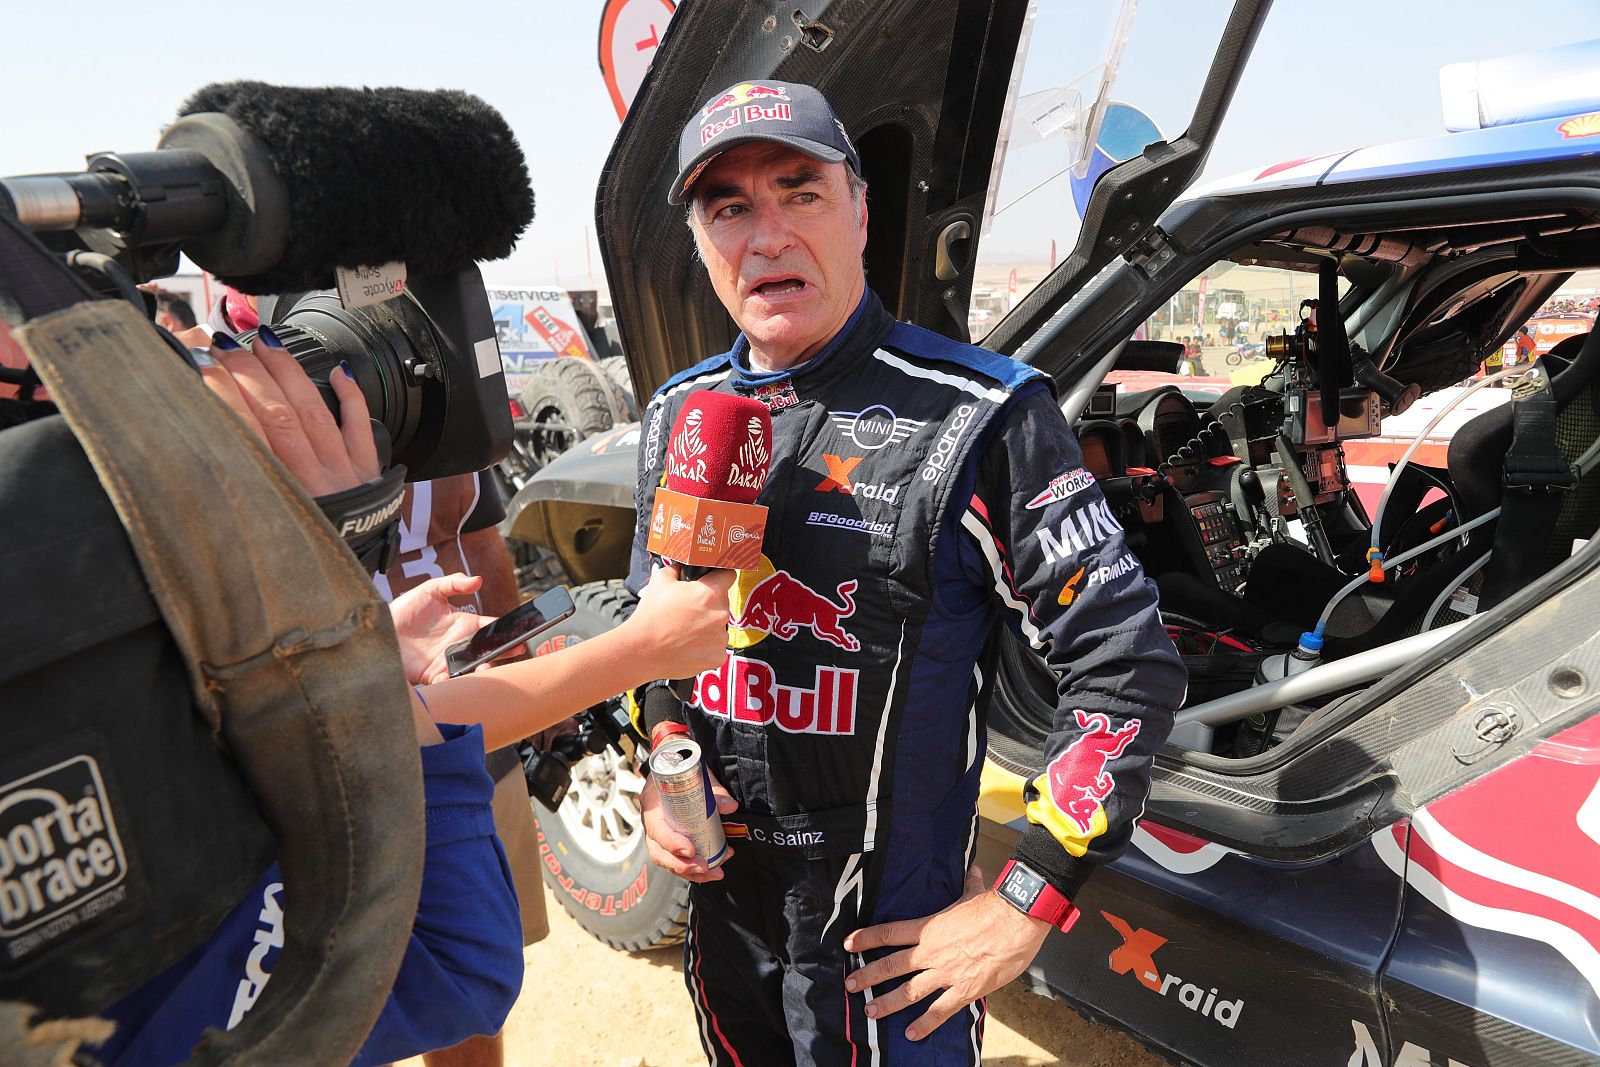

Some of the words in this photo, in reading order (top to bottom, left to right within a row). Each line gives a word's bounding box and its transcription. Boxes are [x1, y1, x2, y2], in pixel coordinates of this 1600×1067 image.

[702, 109, 740, 145] Red
[745, 103, 791, 122] Bull
[363, 277, 396, 297] Rycote
[643, 407, 664, 471] sparco
[857, 420, 892, 436] MINI
[922, 404, 974, 485] sparco
[668, 452, 709, 484] DAKAR
[726, 462, 766, 491] DAKAR
[807, 511, 896, 534] BFGoodrich
[732, 657, 859, 735] Bull
[0, 837, 115, 926] brace
[1100, 909, 1245, 1029] X-raid
